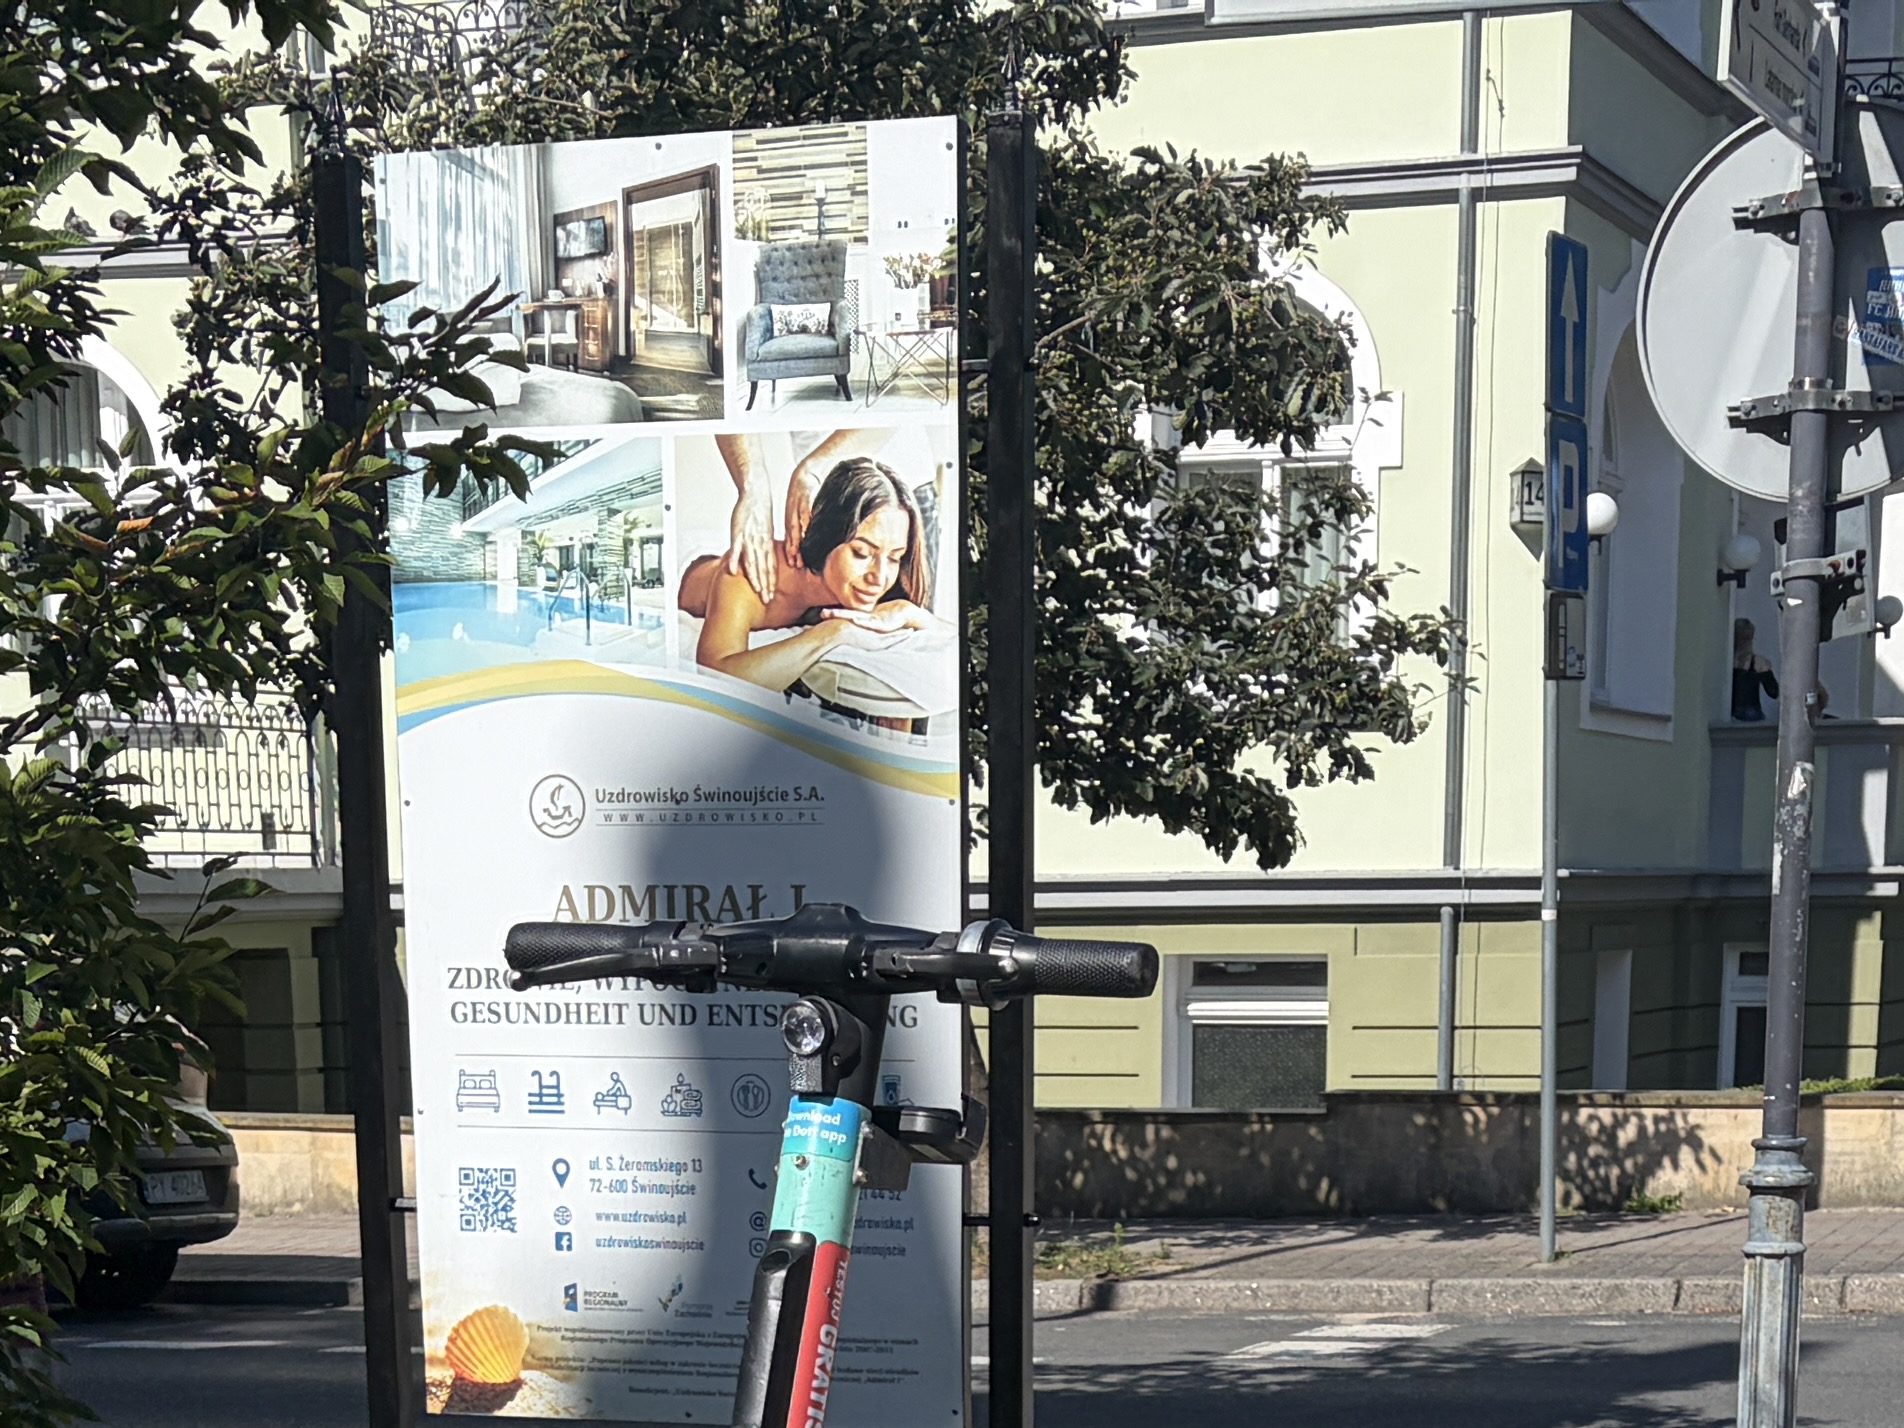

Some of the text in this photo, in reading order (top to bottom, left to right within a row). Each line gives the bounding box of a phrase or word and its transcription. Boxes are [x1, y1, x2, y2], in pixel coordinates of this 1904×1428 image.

[1558, 439, 1579, 568] P
[595, 784, 825, 807] Uzdrowisko Świnoujście S.A.
[553, 884, 767, 923] ADMIRAŁ
[450, 1001, 630, 1025] GESUNDHEIT
[637, 1003, 698, 1026] UND
[820, 1130, 847, 1145] app
[691, 1158, 703, 1173] 13
